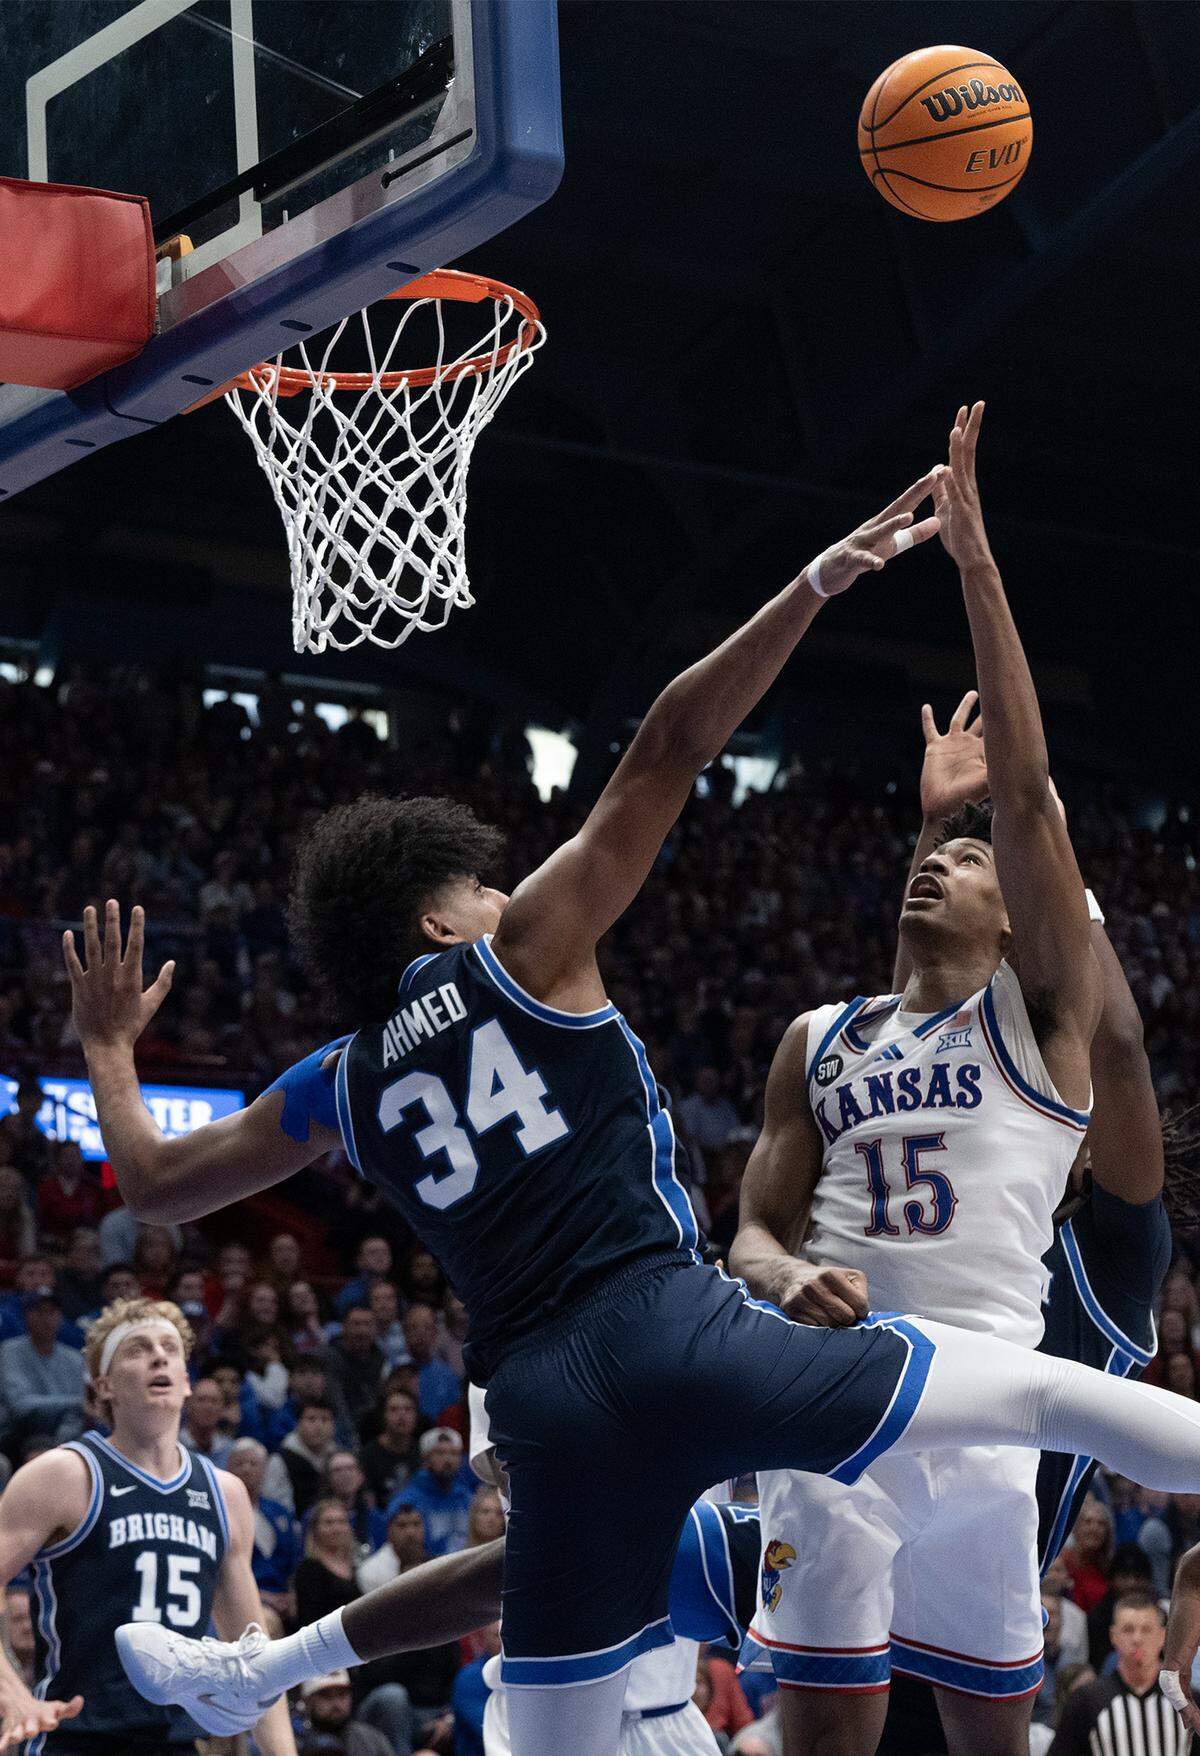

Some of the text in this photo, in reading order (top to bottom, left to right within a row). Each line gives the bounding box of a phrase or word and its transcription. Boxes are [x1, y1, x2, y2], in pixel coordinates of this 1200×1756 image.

[920, 79, 1024, 122] Wilson
[382, 982, 469, 1069] AHMED
[816, 1062, 983, 1146] KANSAS
[817, 1059, 840, 1081] SW
[378, 1015, 574, 1211] 34
[855, 1131, 959, 1236] 15
[109, 1512, 217, 1561] BRIGHAM
[132, 1551, 202, 1627] 15
